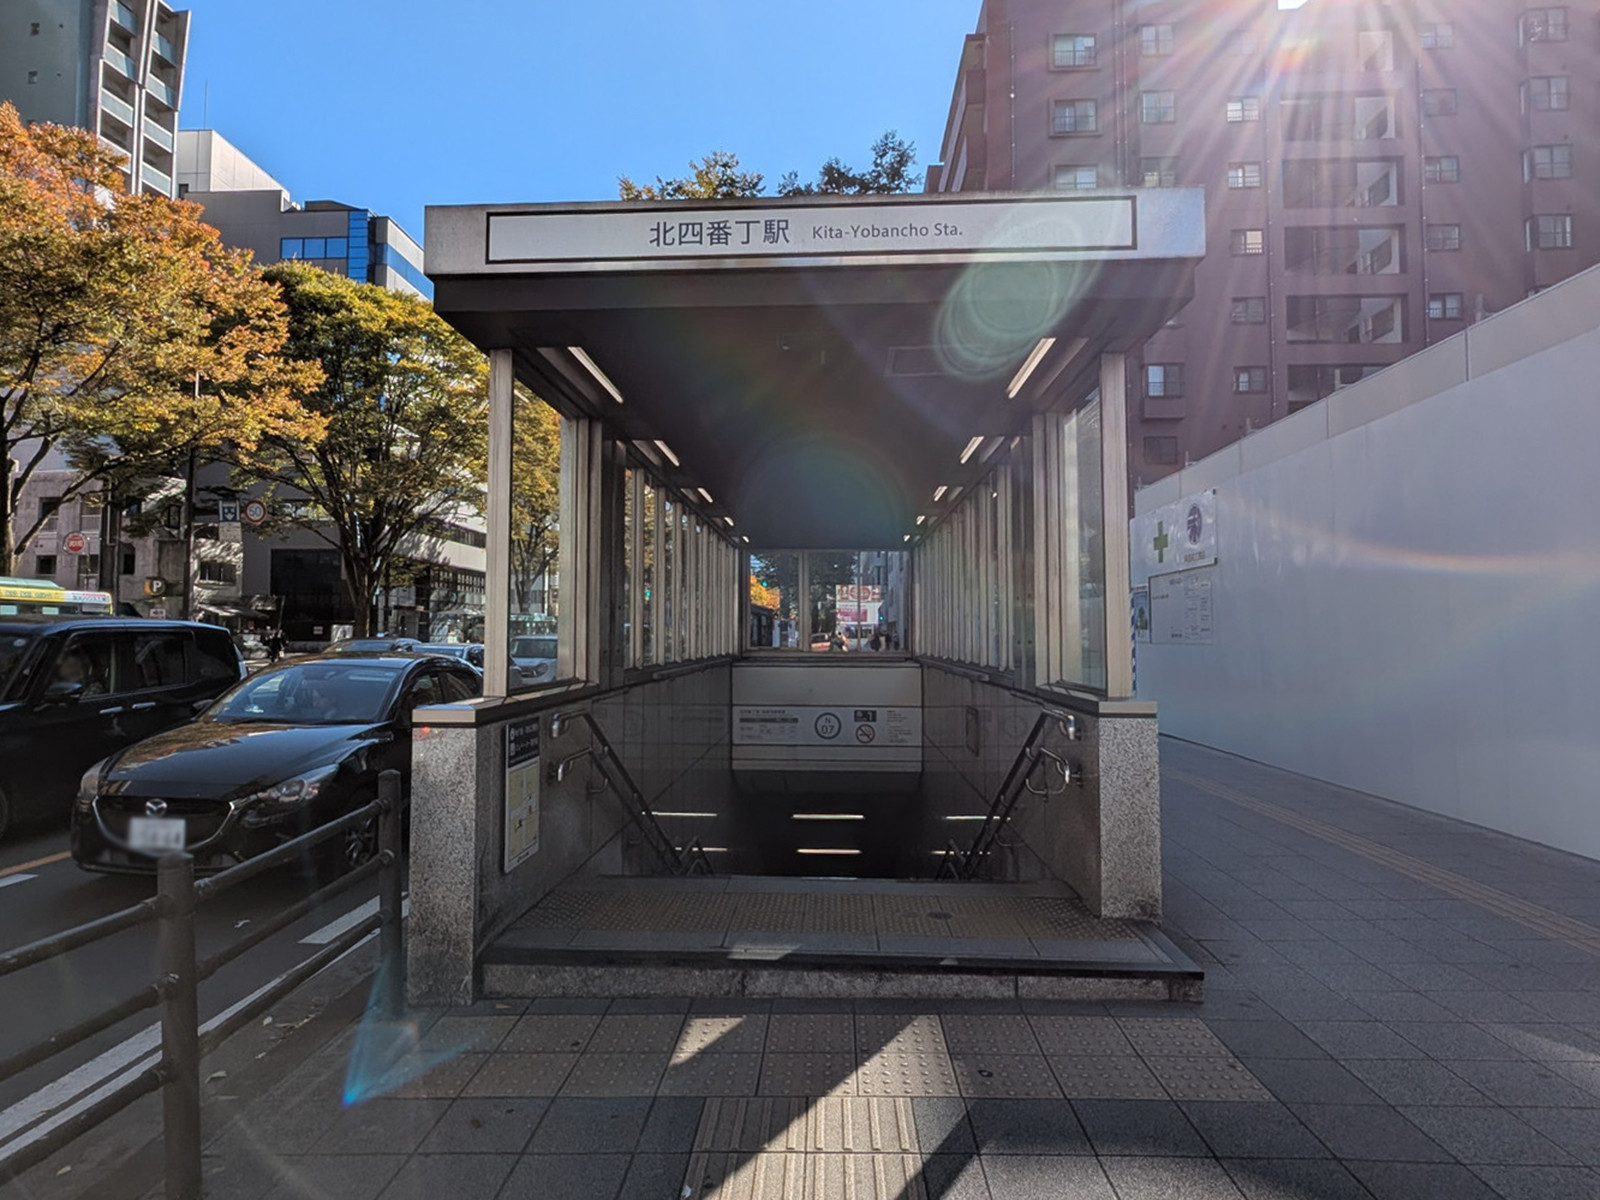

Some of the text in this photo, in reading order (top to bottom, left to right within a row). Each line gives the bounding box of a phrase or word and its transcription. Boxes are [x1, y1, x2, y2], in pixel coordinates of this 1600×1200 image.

[649, 219, 790, 247] 北四番丁駅
[812, 222, 963, 239] Kita-Yobancho Sta.
[153, 580, 162, 593] P
[821, 725, 834, 735] 07
